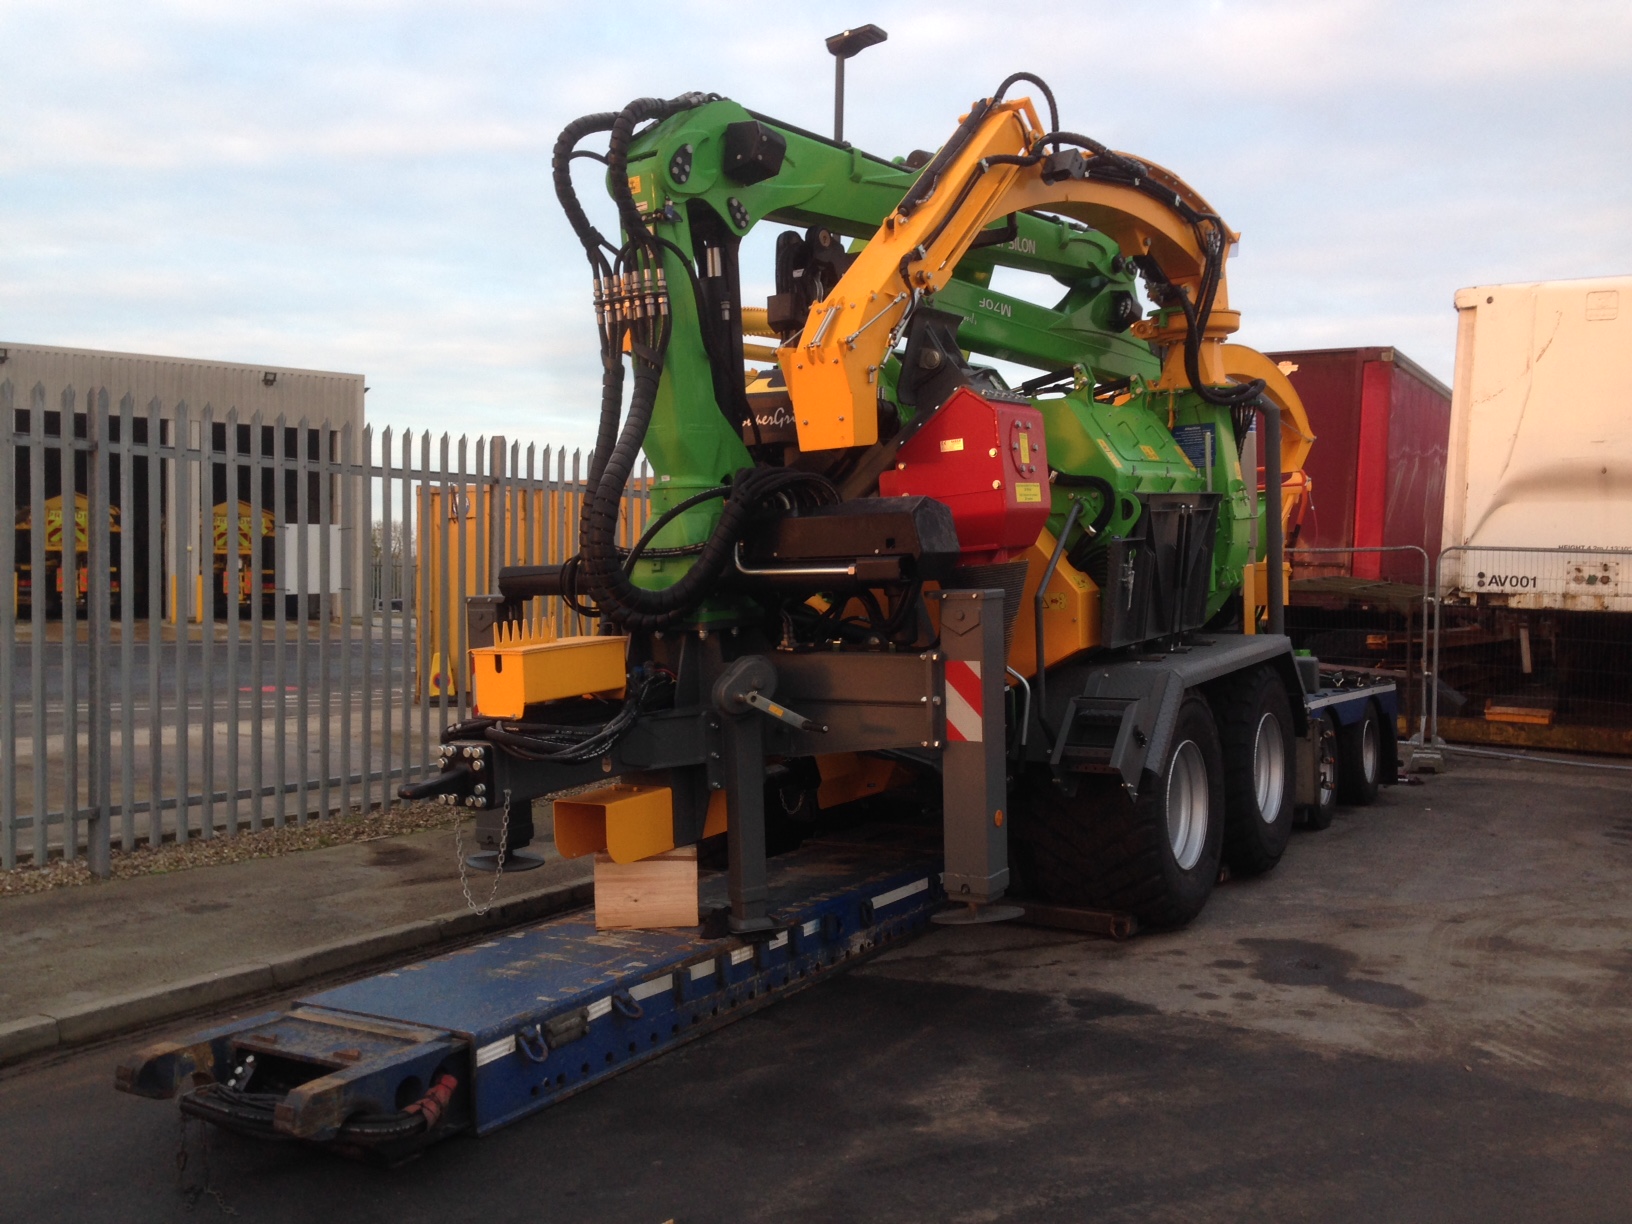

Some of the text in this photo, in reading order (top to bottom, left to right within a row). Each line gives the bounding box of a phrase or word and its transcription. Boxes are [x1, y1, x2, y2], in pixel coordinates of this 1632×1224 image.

[996, 236, 1036, 254] SILON
[978, 297, 1012, 318] M70F
[1488, 574, 1537, 588] AV001
